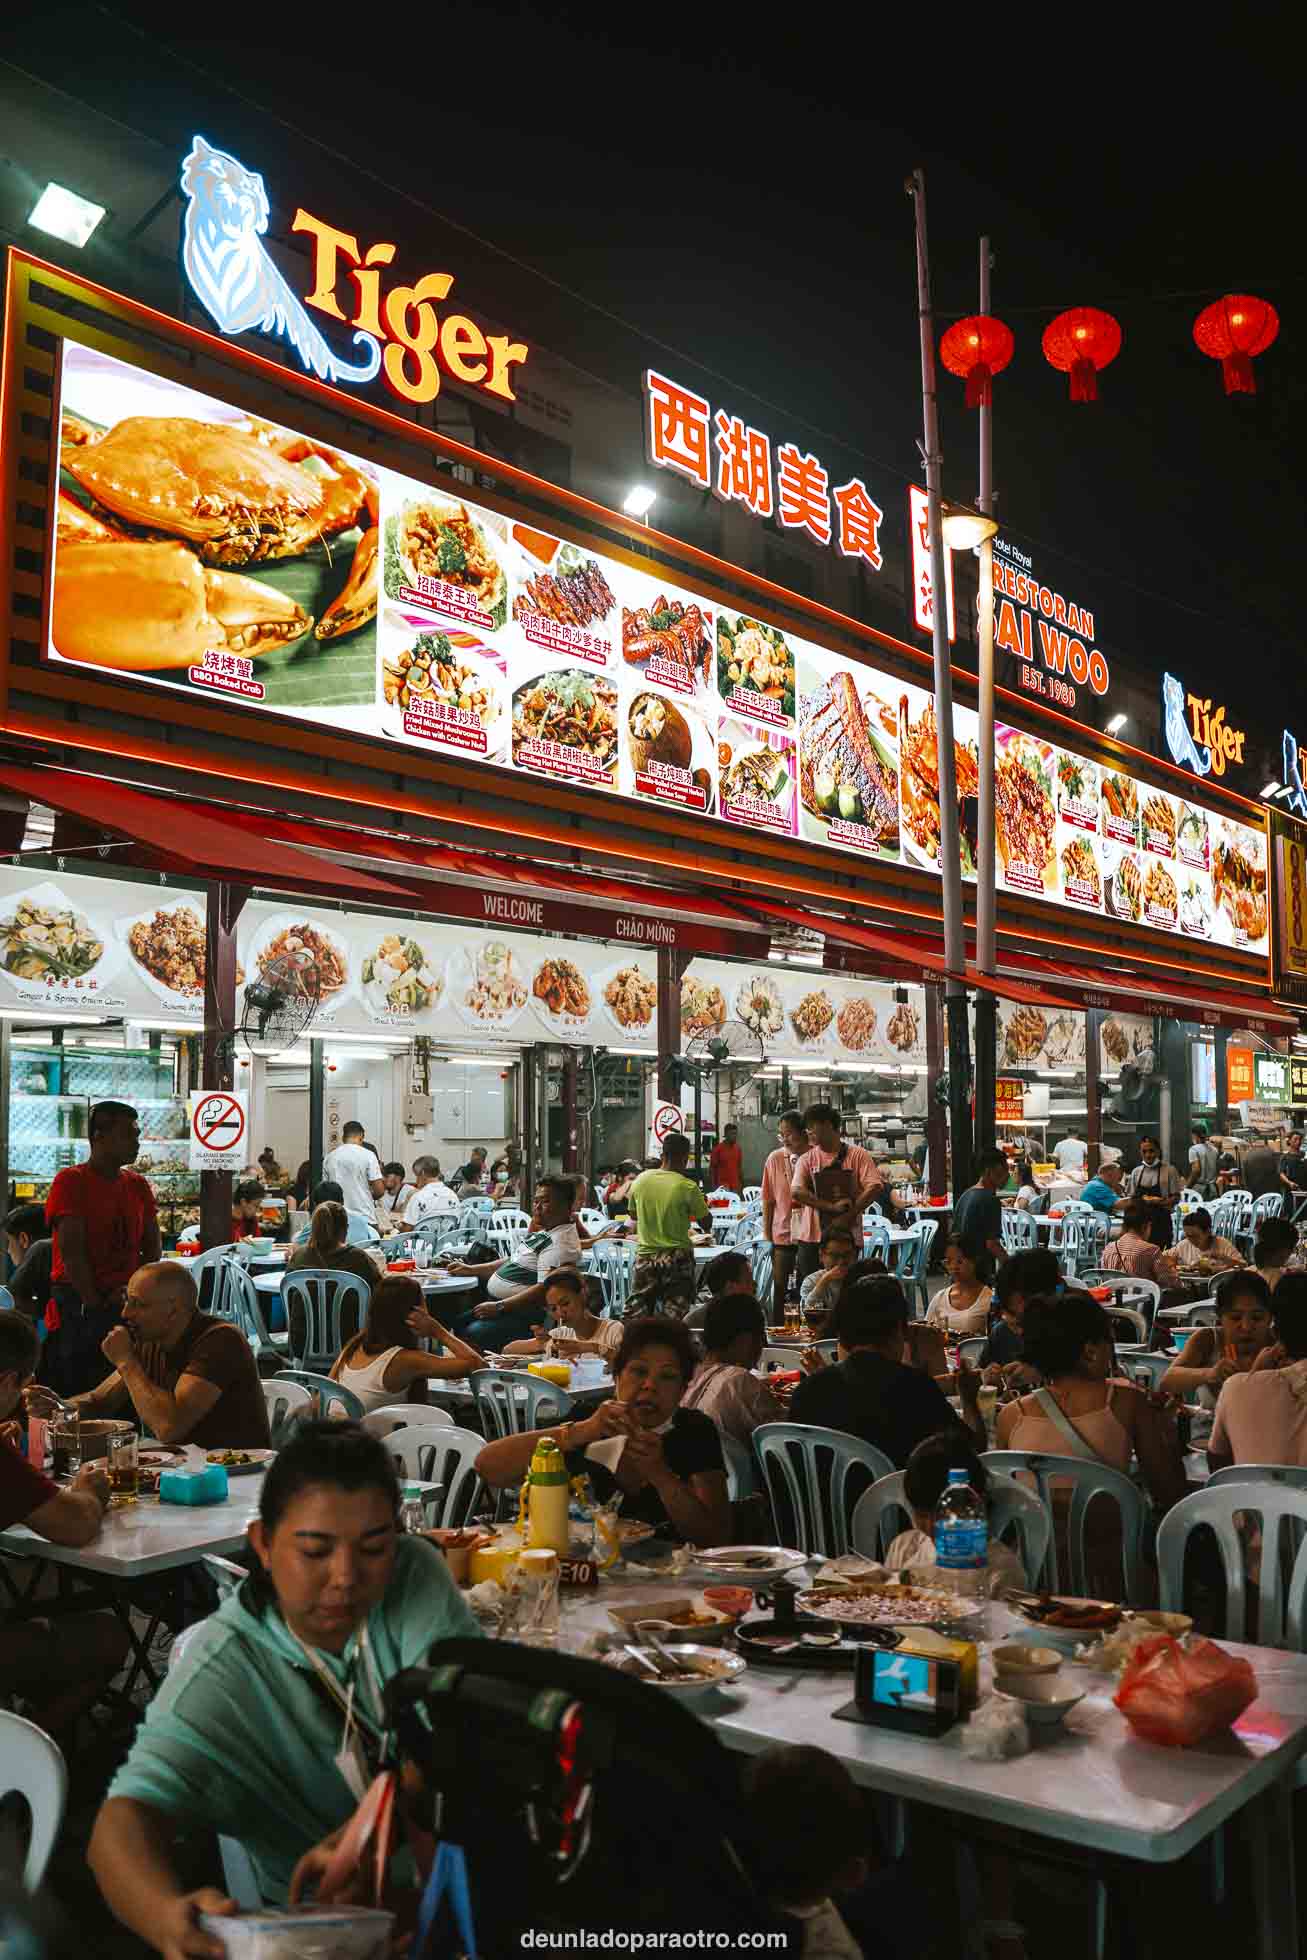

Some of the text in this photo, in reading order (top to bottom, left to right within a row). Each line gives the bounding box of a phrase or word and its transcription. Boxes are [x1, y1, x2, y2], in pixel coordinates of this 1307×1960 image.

[291, 208, 529, 402] Tiger
[647, 369, 884, 571] 西湖美食
[1012, 546, 1032, 568] Royal
[417, 574, 478, 610] 招牌泰王鸡
[992, 560, 1094, 641] RESTORAN
[468, 611, 493, 625] Chicken
[205, 650, 251, 678] 烧烤蟹
[1039, 619, 1109, 695] WOO
[194, 669, 262, 695] BBQ Baked Crab
[1022, 664, 1076, 708] EST. 1980
[405, 713, 422, 725] Fried
[424, 718, 443, 730] Mixed
[444, 723, 479, 740] Mushrooms
[410, 696, 481, 729] 杂菇腰果炒鸡
[406, 724, 431, 737] Chicken
[432, 730, 446, 740] with
[446, 734, 471, 746] Cashew
[1187, 693, 1245, 776] Tiger
[482, 895, 544, 923] WELCOME
[560, 1563, 590, 1583] E10
